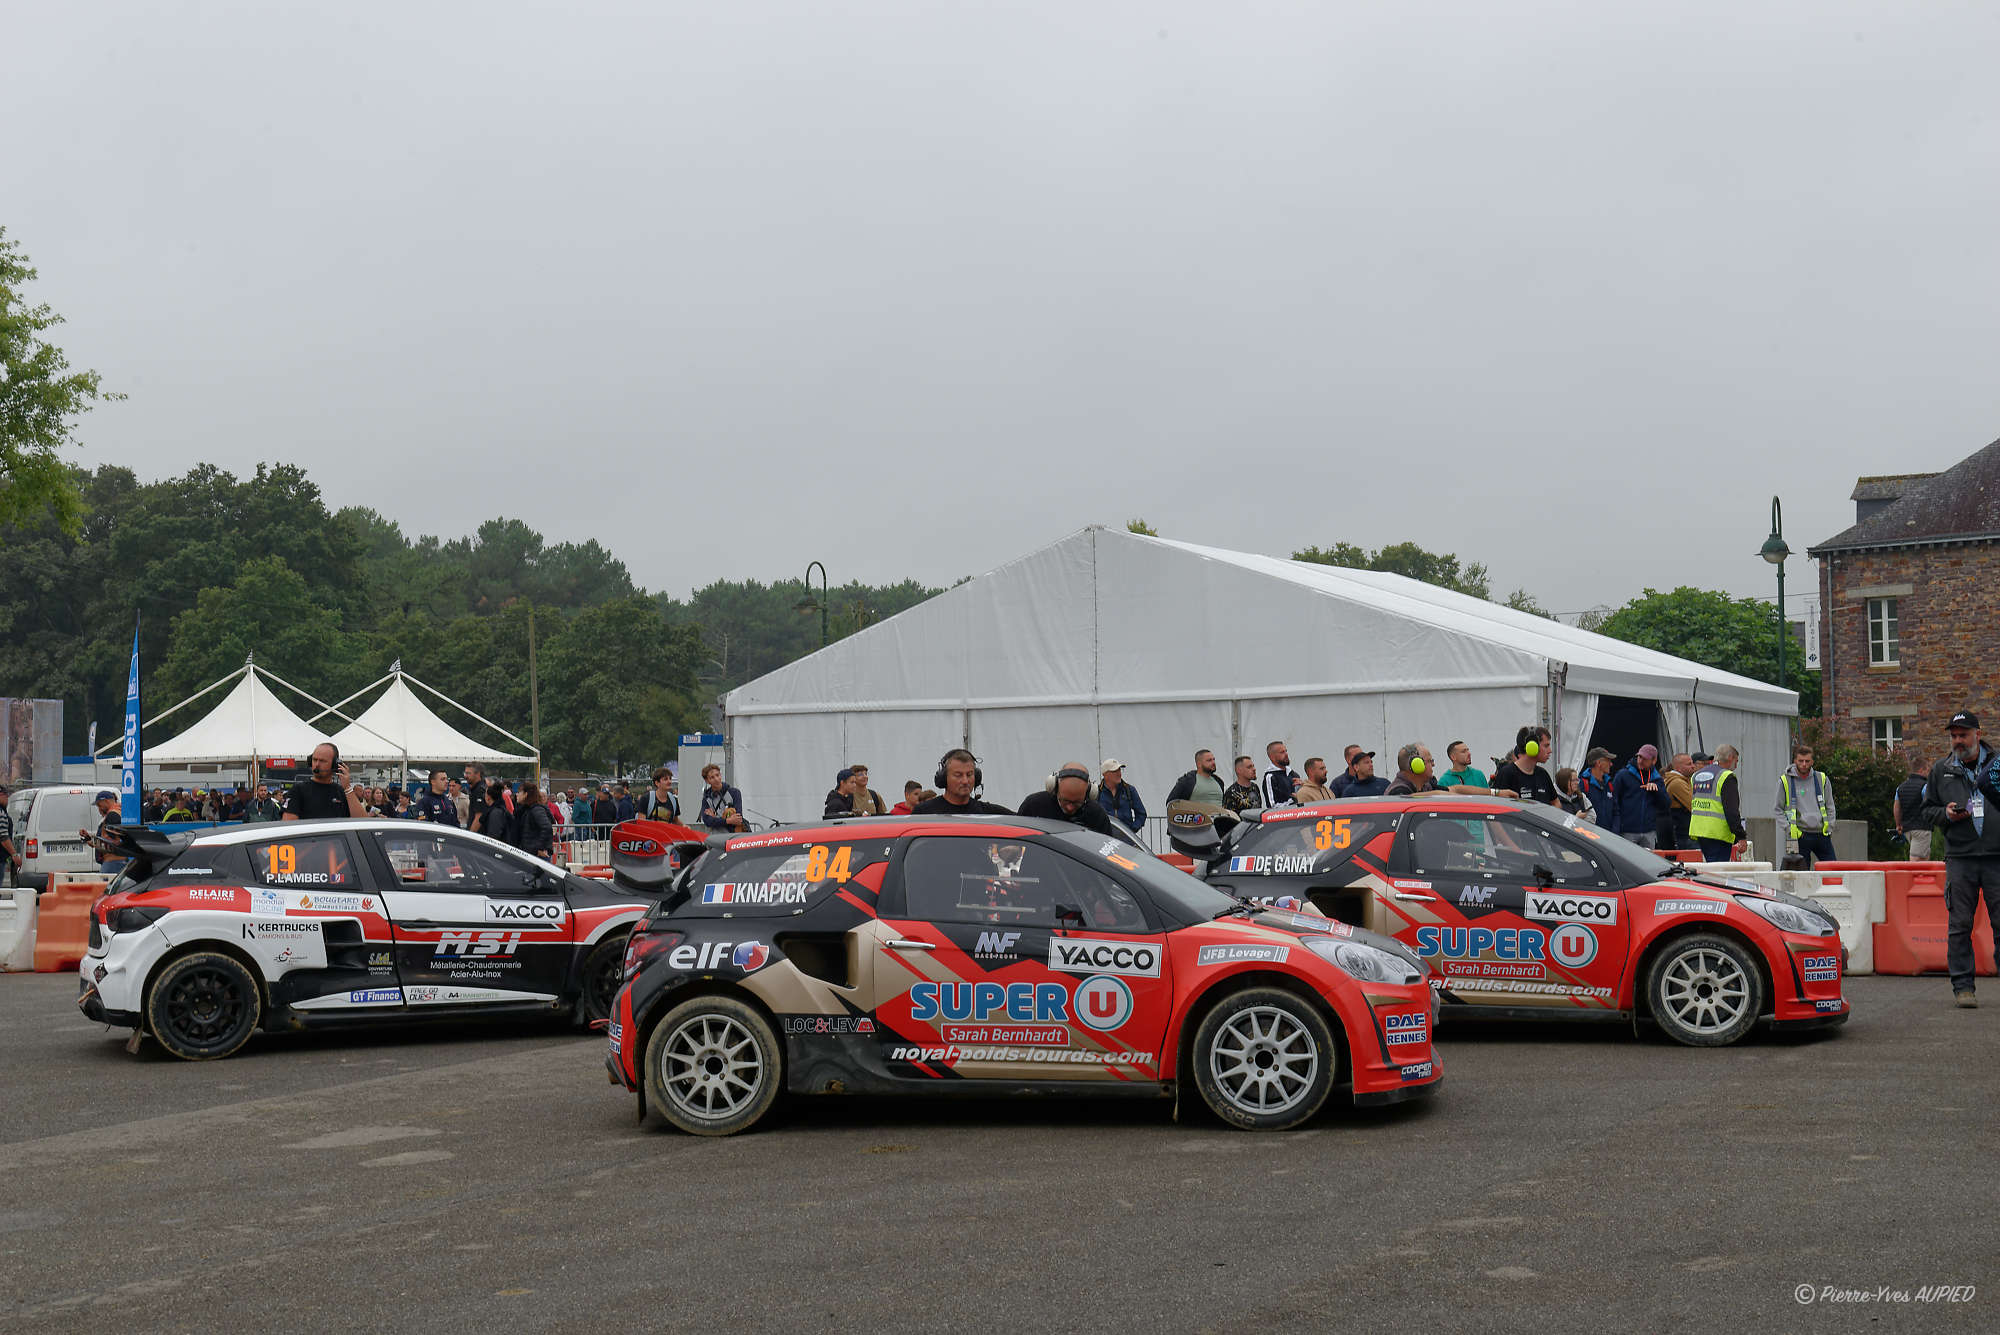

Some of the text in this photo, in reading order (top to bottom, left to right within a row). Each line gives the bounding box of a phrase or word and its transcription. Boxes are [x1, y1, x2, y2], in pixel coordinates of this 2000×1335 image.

[121, 713, 136, 794] bleu
[1173, 813, 1193, 824] elf
[1315, 818, 1352, 850] 35
[618, 840, 643, 852] elf
[730, 836, 793, 850] adecom-photo
[267, 844, 296, 875] 19
[806, 845, 853, 883] 84
[1255, 856, 1317, 873] DE GANAY
[266, 873, 328, 883] P.LAMBEC
[189, 889, 235, 898] DELAIRE
[735, 882, 809, 904] KNAPICK
[489, 904, 560, 919] YACCO
[1532, 898, 1611, 919] YACCO
[1658, 902, 1713, 912] JFB Levage
[258, 923, 319, 932] KERTRUCKS
[1416, 926, 1585, 960] SUPER U
[668, 942, 732, 970] elf
[1057, 944, 1154, 970] YACCO
[1203, 947, 1272, 960] JFB Levage
[430, 960, 522, 969] Métallerie-Chaudronnerie
[1803, 956, 1837, 969] DAF
[450, 970, 502, 978] Acier-Alu-Inox
[1447, 963, 1540, 977] Sarah Bernhardt
[1804, 970, 1838, 982] RENNES
[352, 990, 400, 1001] GT Finance
[910, 981, 1117, 1022] SUPER U
[1815, 1000, 1842, 1009] COOPER
[1385, 1013, 1425, 1028] DAF
[949, 1027, 1062, 1043] Sarah Bernhardt
[1386, 1032, 1427, 1044] RENNES
[891, 1045, 1153, 1065] noyal-poids-lourds.com
[1401, 1063, 1432, 1076] COOPER
